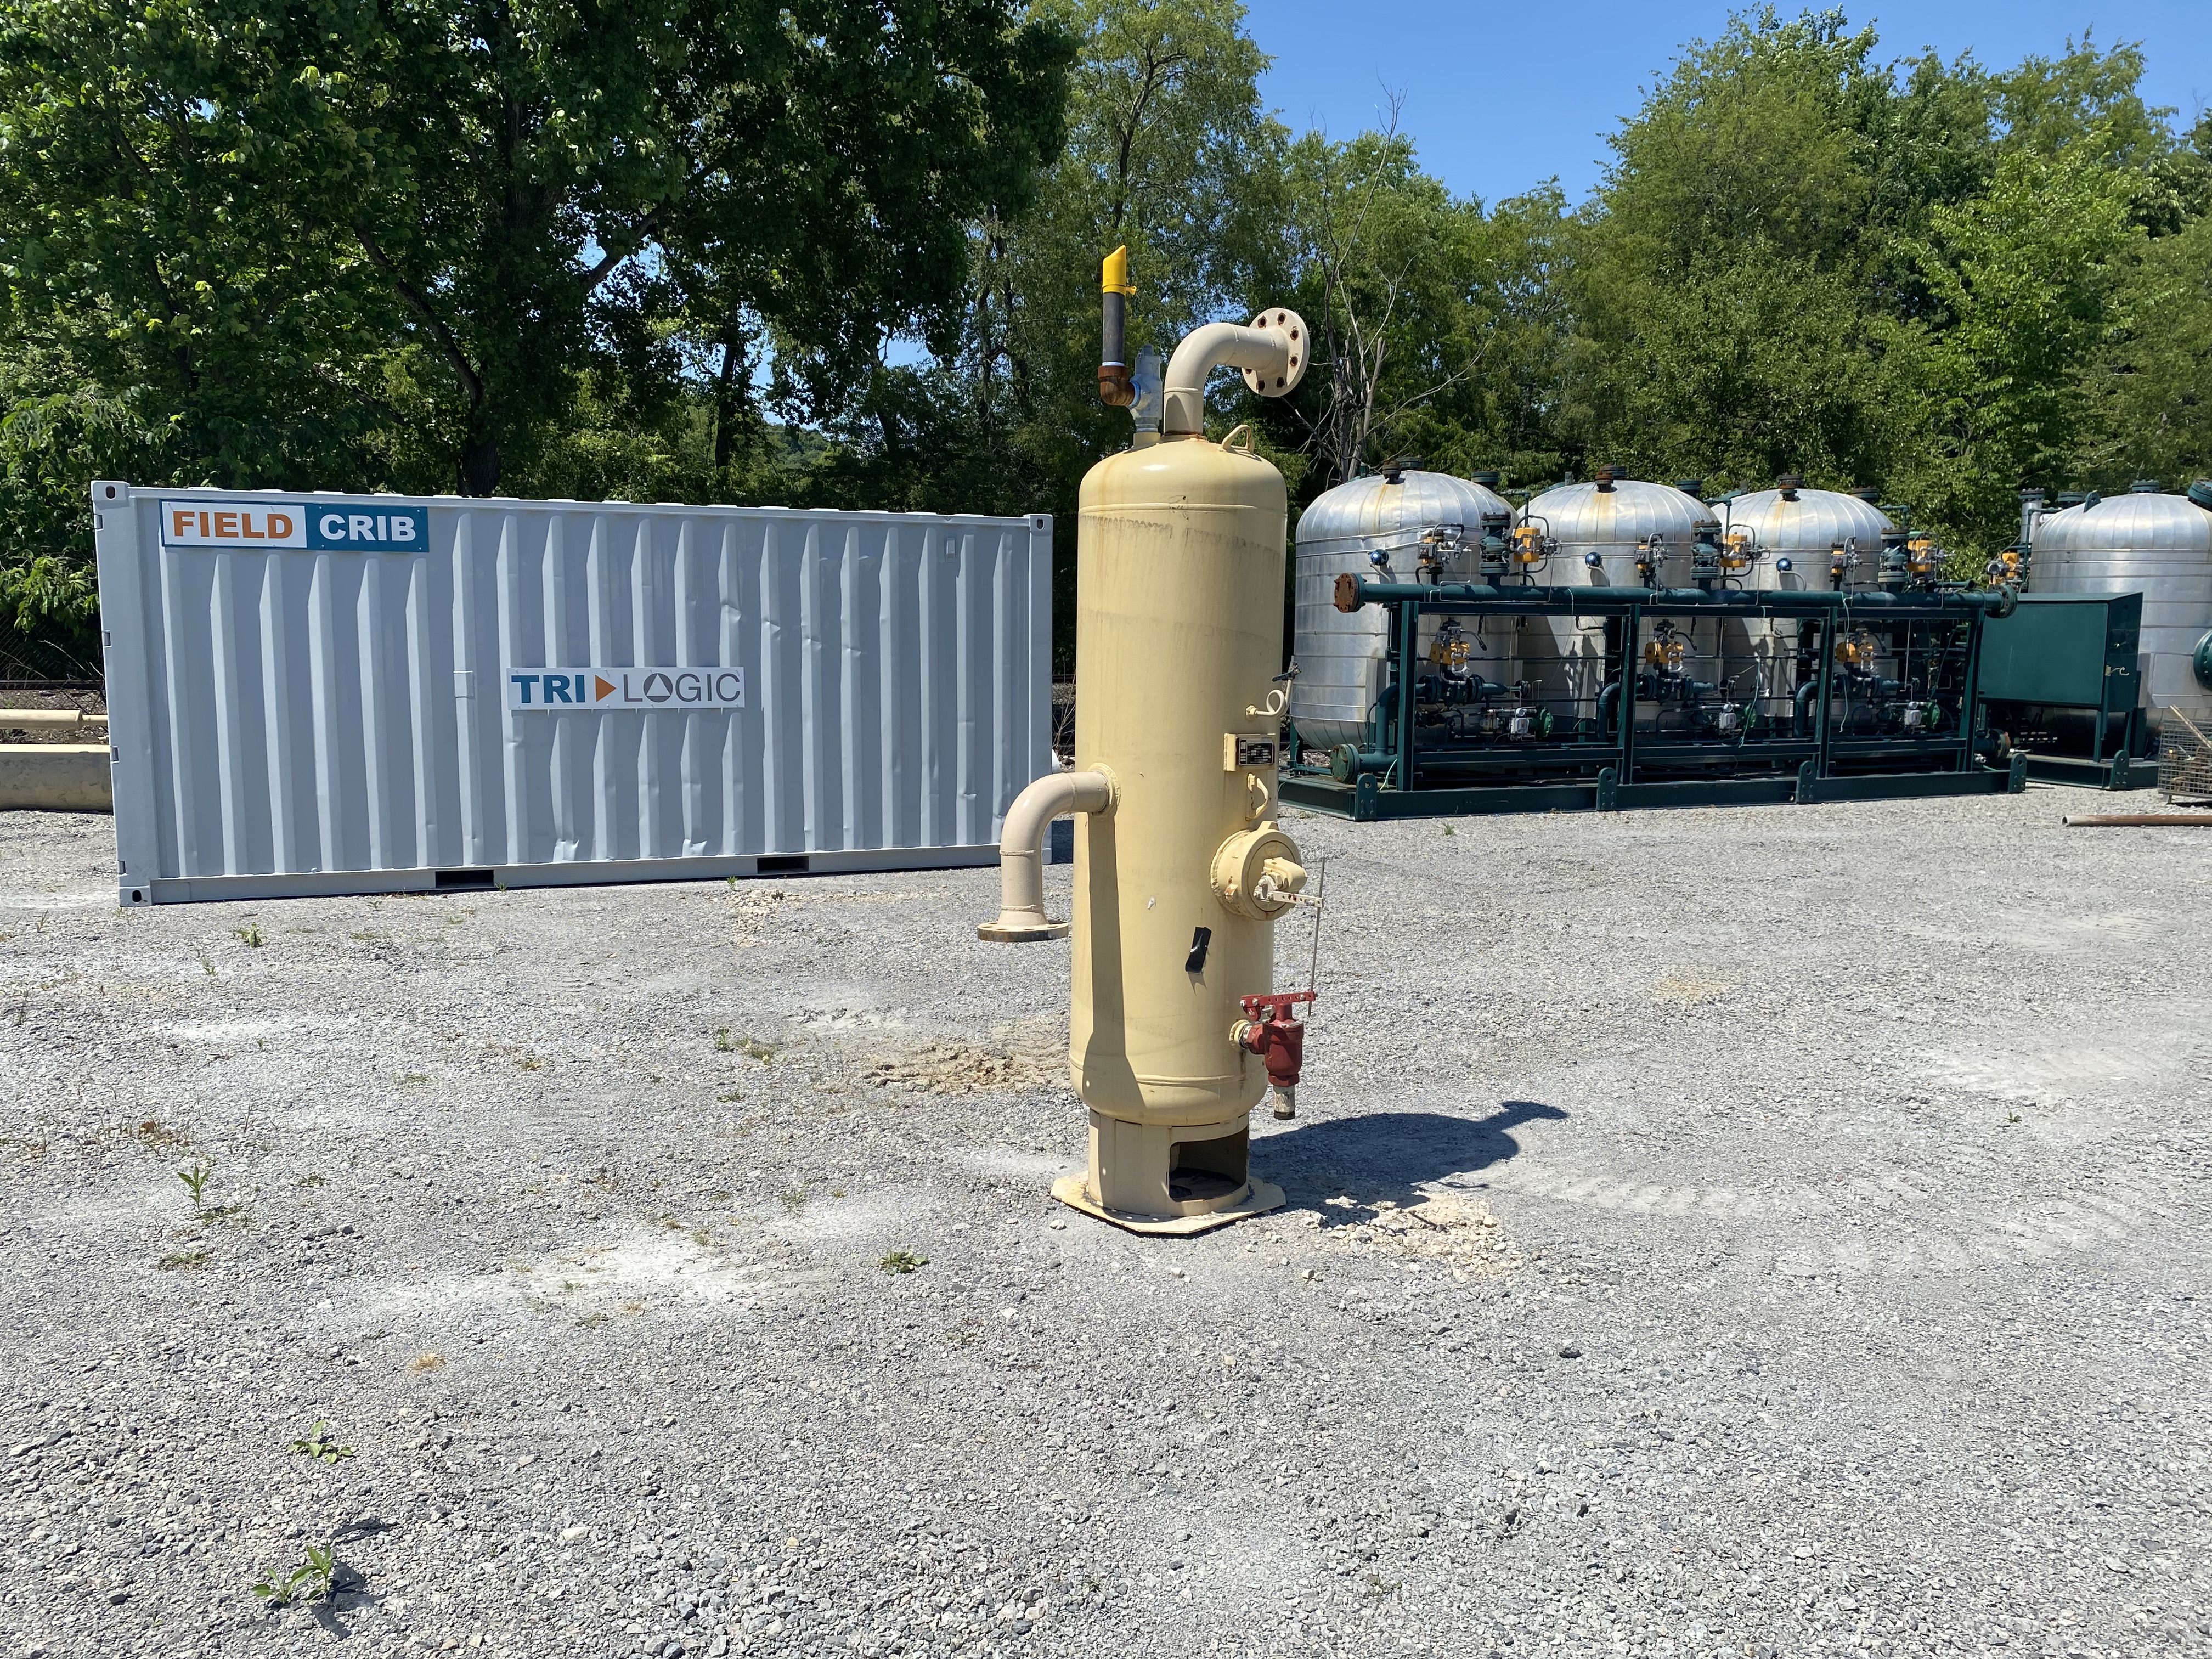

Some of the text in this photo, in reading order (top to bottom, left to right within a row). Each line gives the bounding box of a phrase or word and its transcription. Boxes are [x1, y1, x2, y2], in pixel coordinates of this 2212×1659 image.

[173, 511, 416, 541] FIELD CRIB
[511, 673, 740, 703] TRI LOGIC
